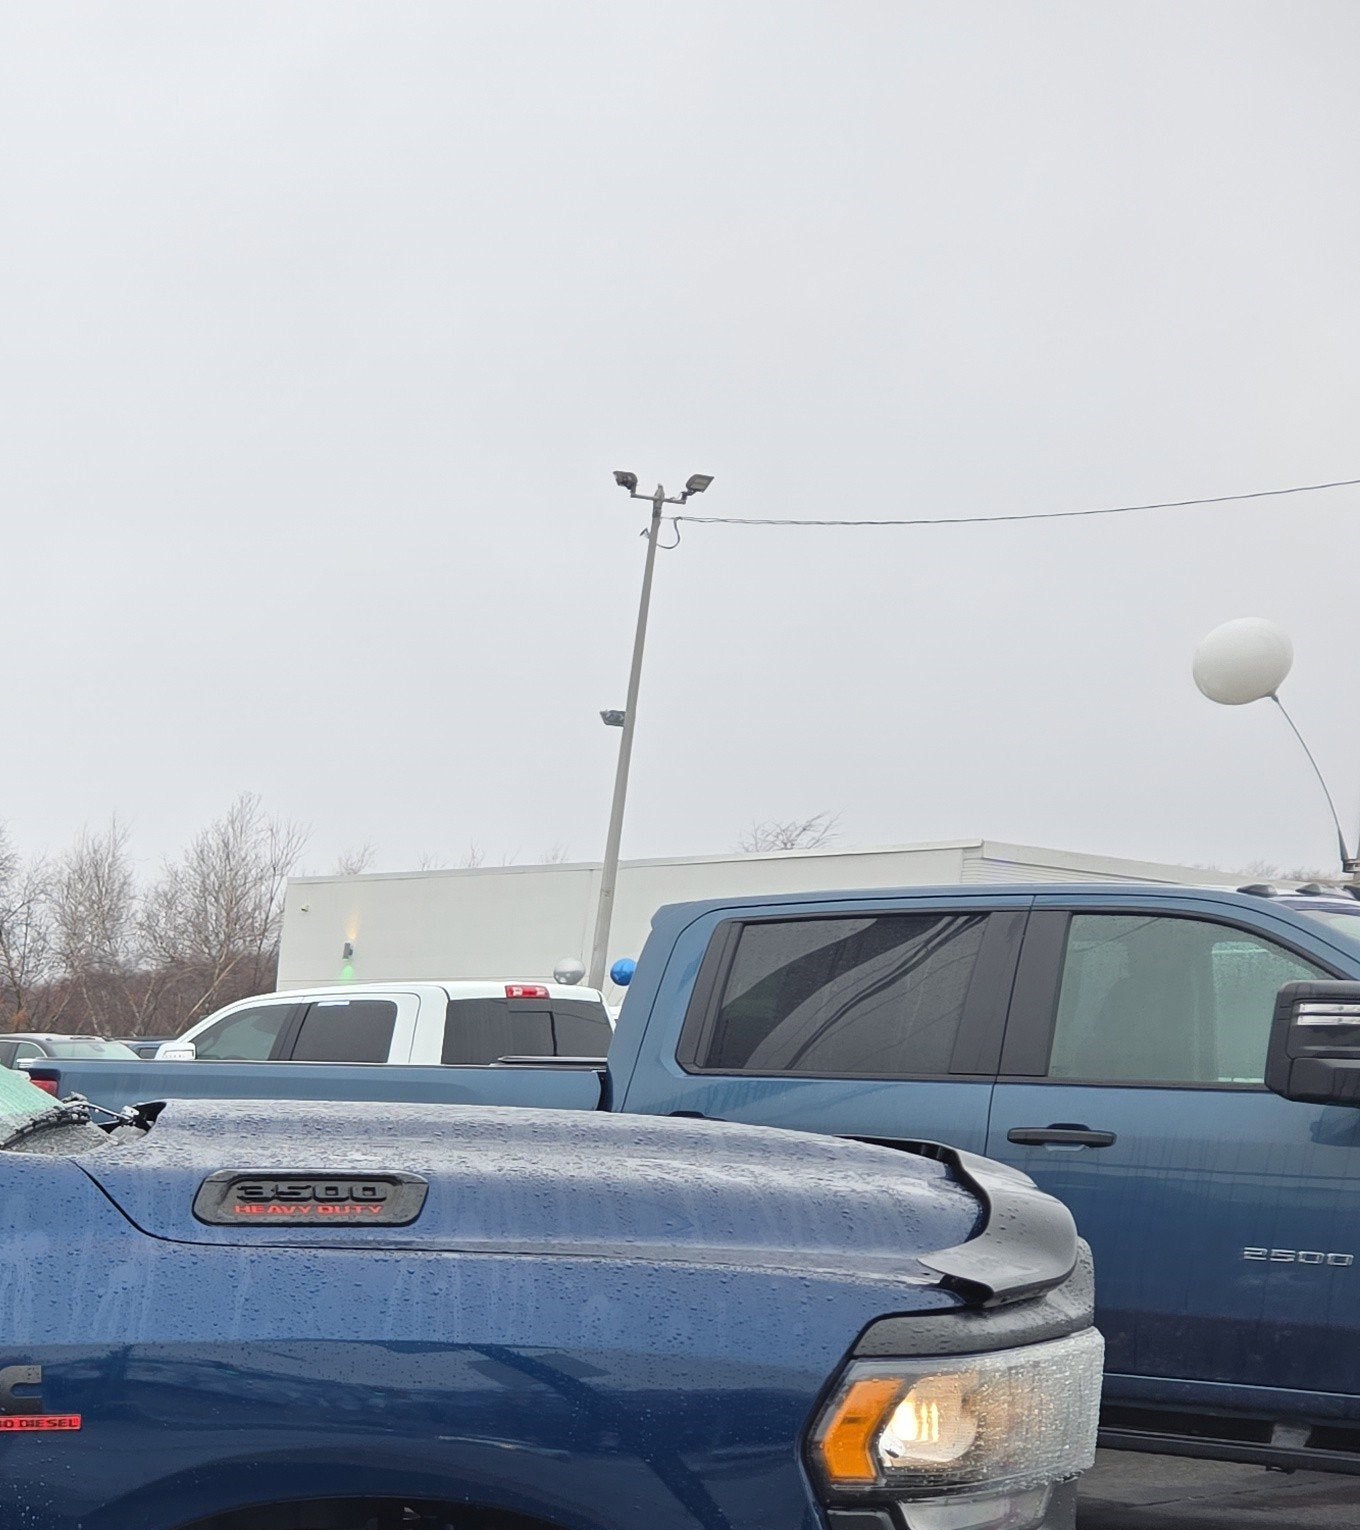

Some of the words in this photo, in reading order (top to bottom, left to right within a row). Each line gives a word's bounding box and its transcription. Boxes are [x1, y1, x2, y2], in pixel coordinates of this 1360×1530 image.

[236, 1184, 388, 1203] 3500
[234, 1204, 312, 1217] HEAVY
[317, 1203, 385, 1216] DUTY
[1243, 1246, 1355, 1267] 2500
[18, 1418, 79, 1429] DIESEL
